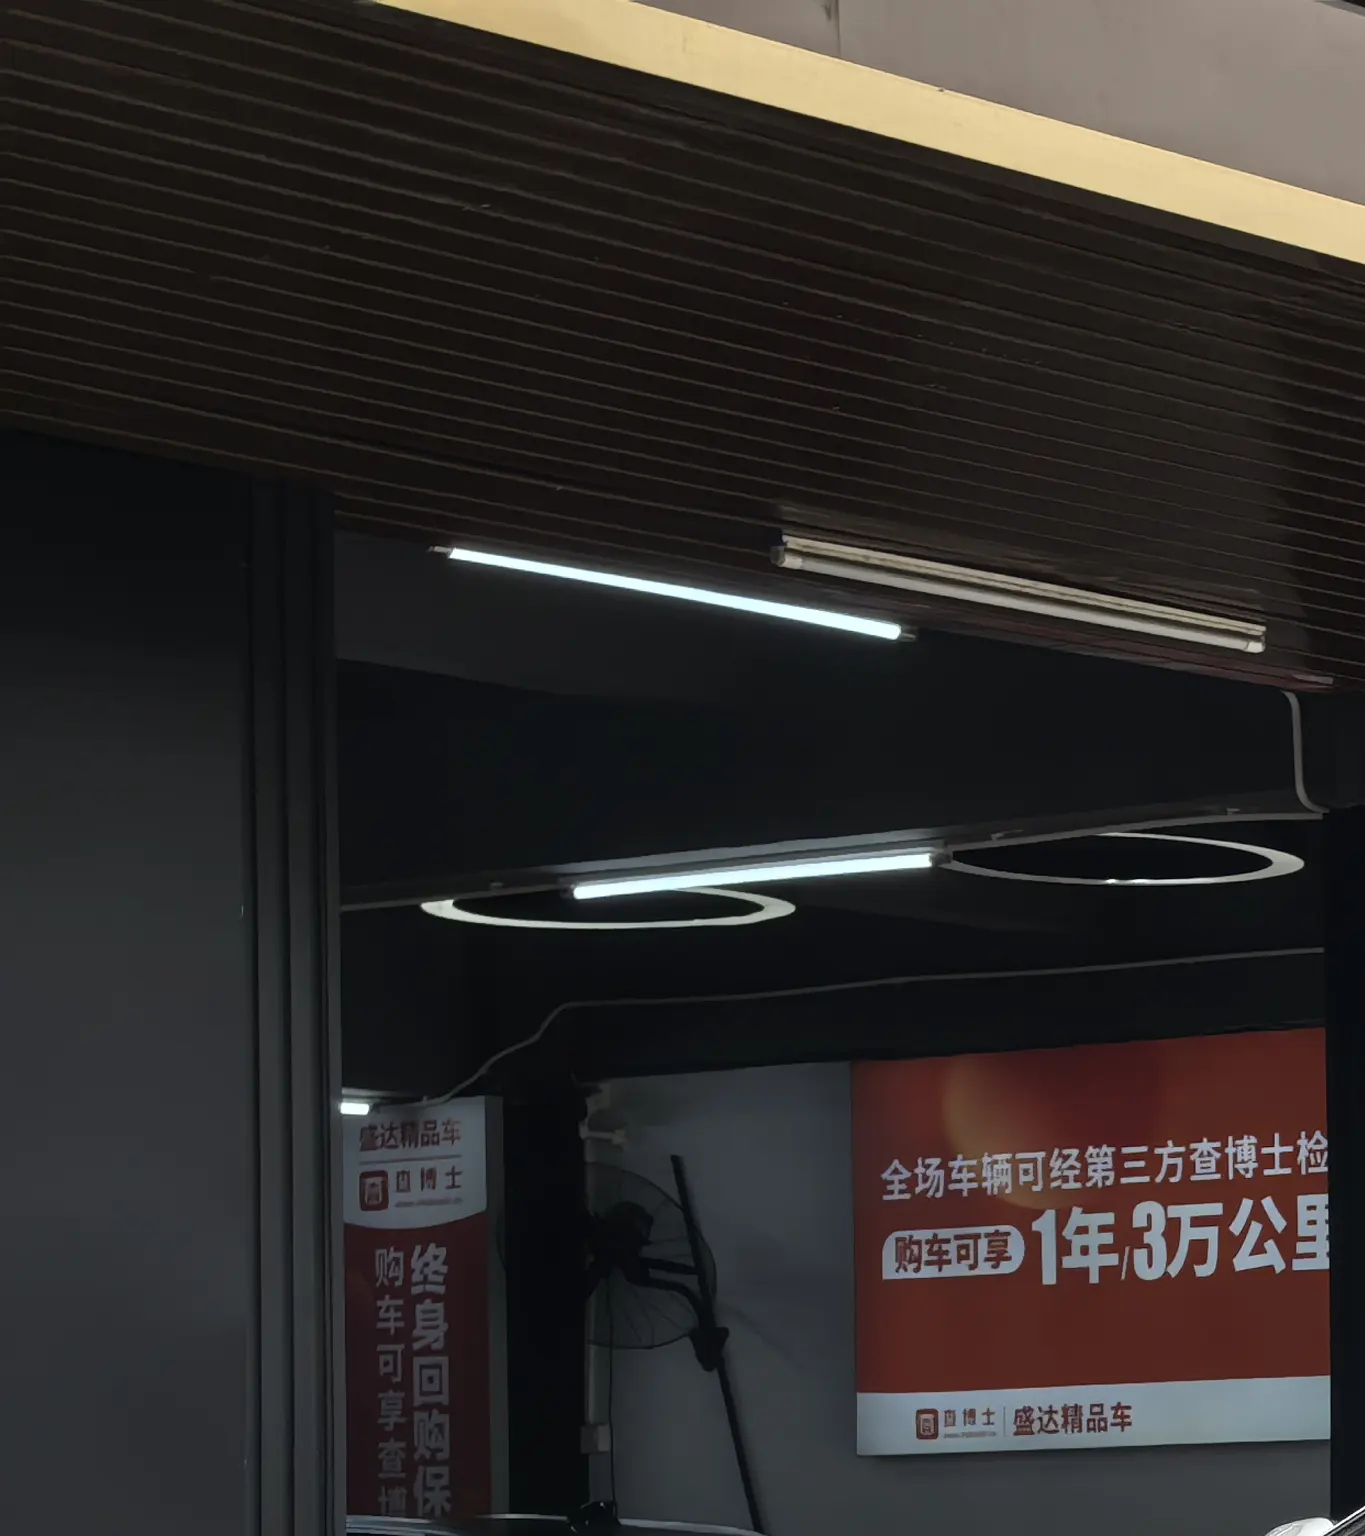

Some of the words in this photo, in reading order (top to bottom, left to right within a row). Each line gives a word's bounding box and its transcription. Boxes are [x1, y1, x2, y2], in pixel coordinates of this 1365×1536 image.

[879, 1130, 1329, 1202] 全场车辆可经第三方查博士检
[893, 1229, 1013, 1274] 购车可享
[1013, 1401, 1133, 1436] 盛达精品车
